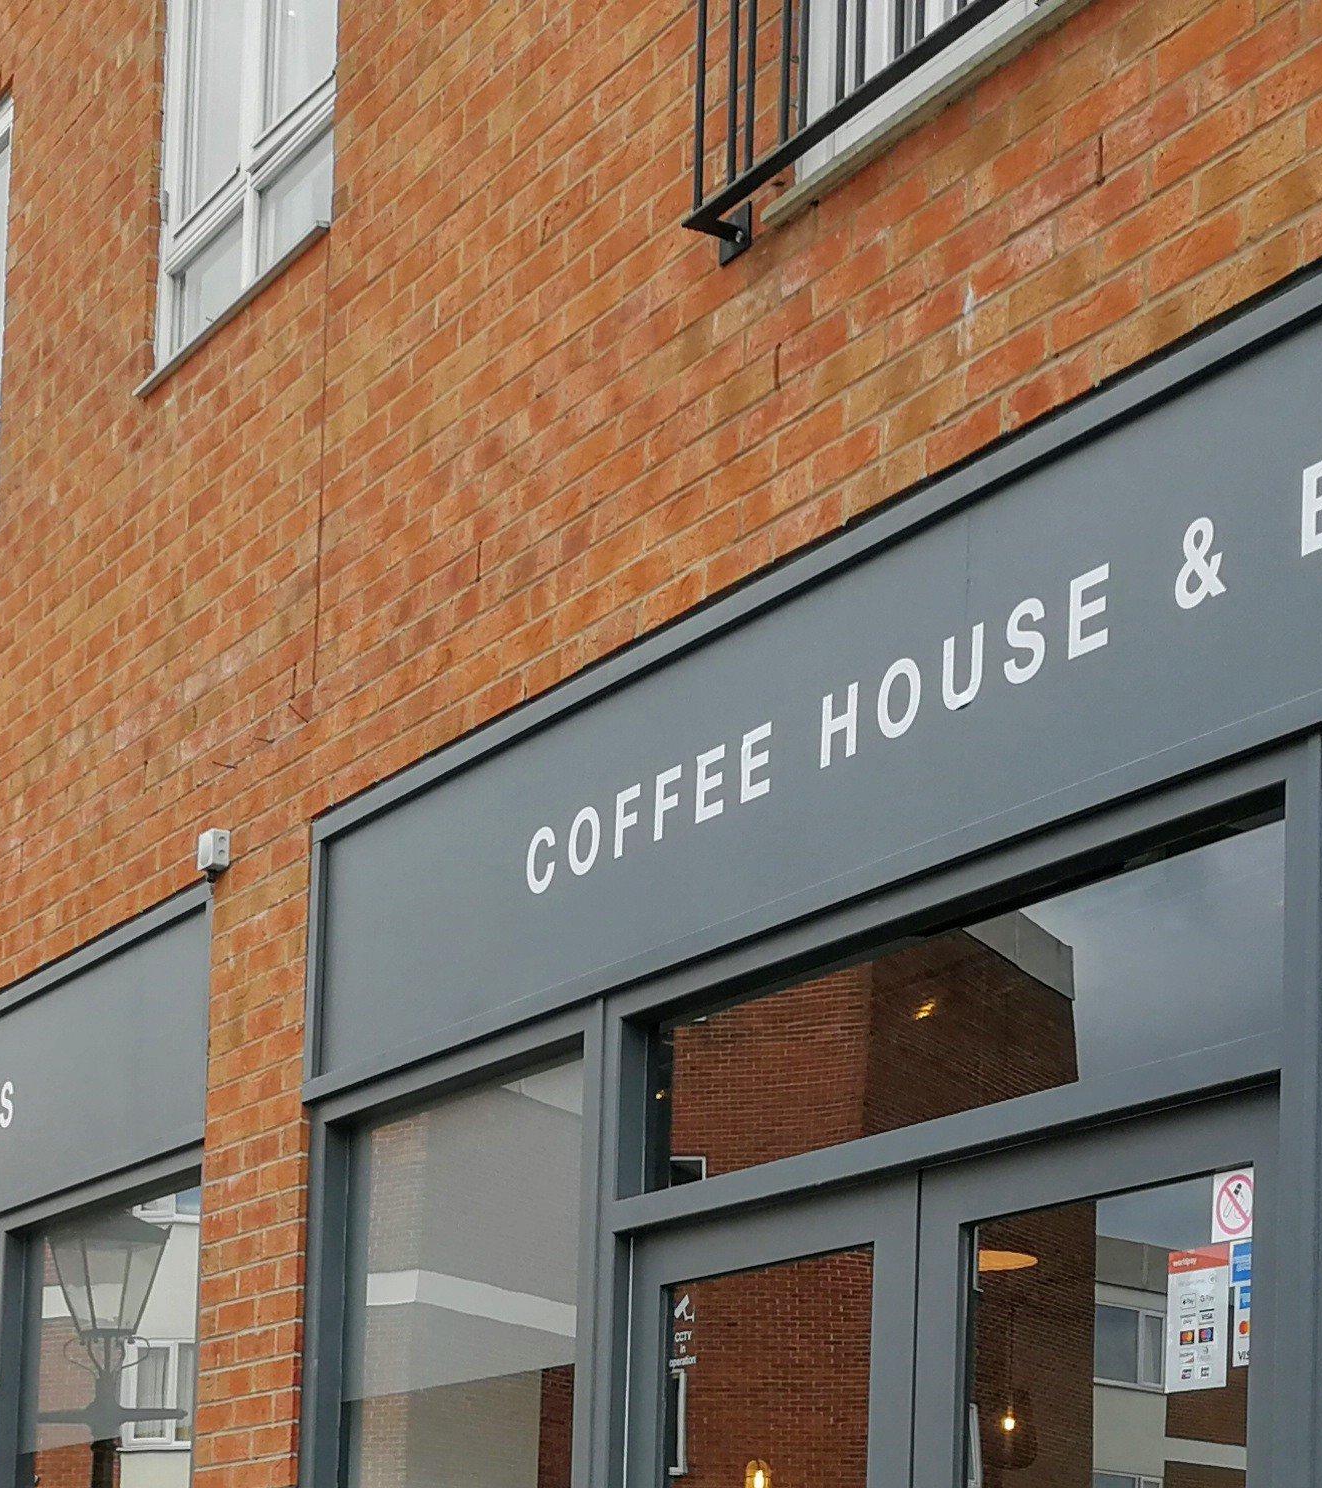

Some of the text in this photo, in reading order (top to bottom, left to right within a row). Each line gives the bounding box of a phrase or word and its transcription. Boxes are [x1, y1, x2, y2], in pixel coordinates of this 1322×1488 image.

[525, 721, 773, 895] COFFEE
[820, 562, 1111, 770] HOUSE
[1175, 515, 1227, 609] &
[1237, 1350, 1251, 1361] VIS
